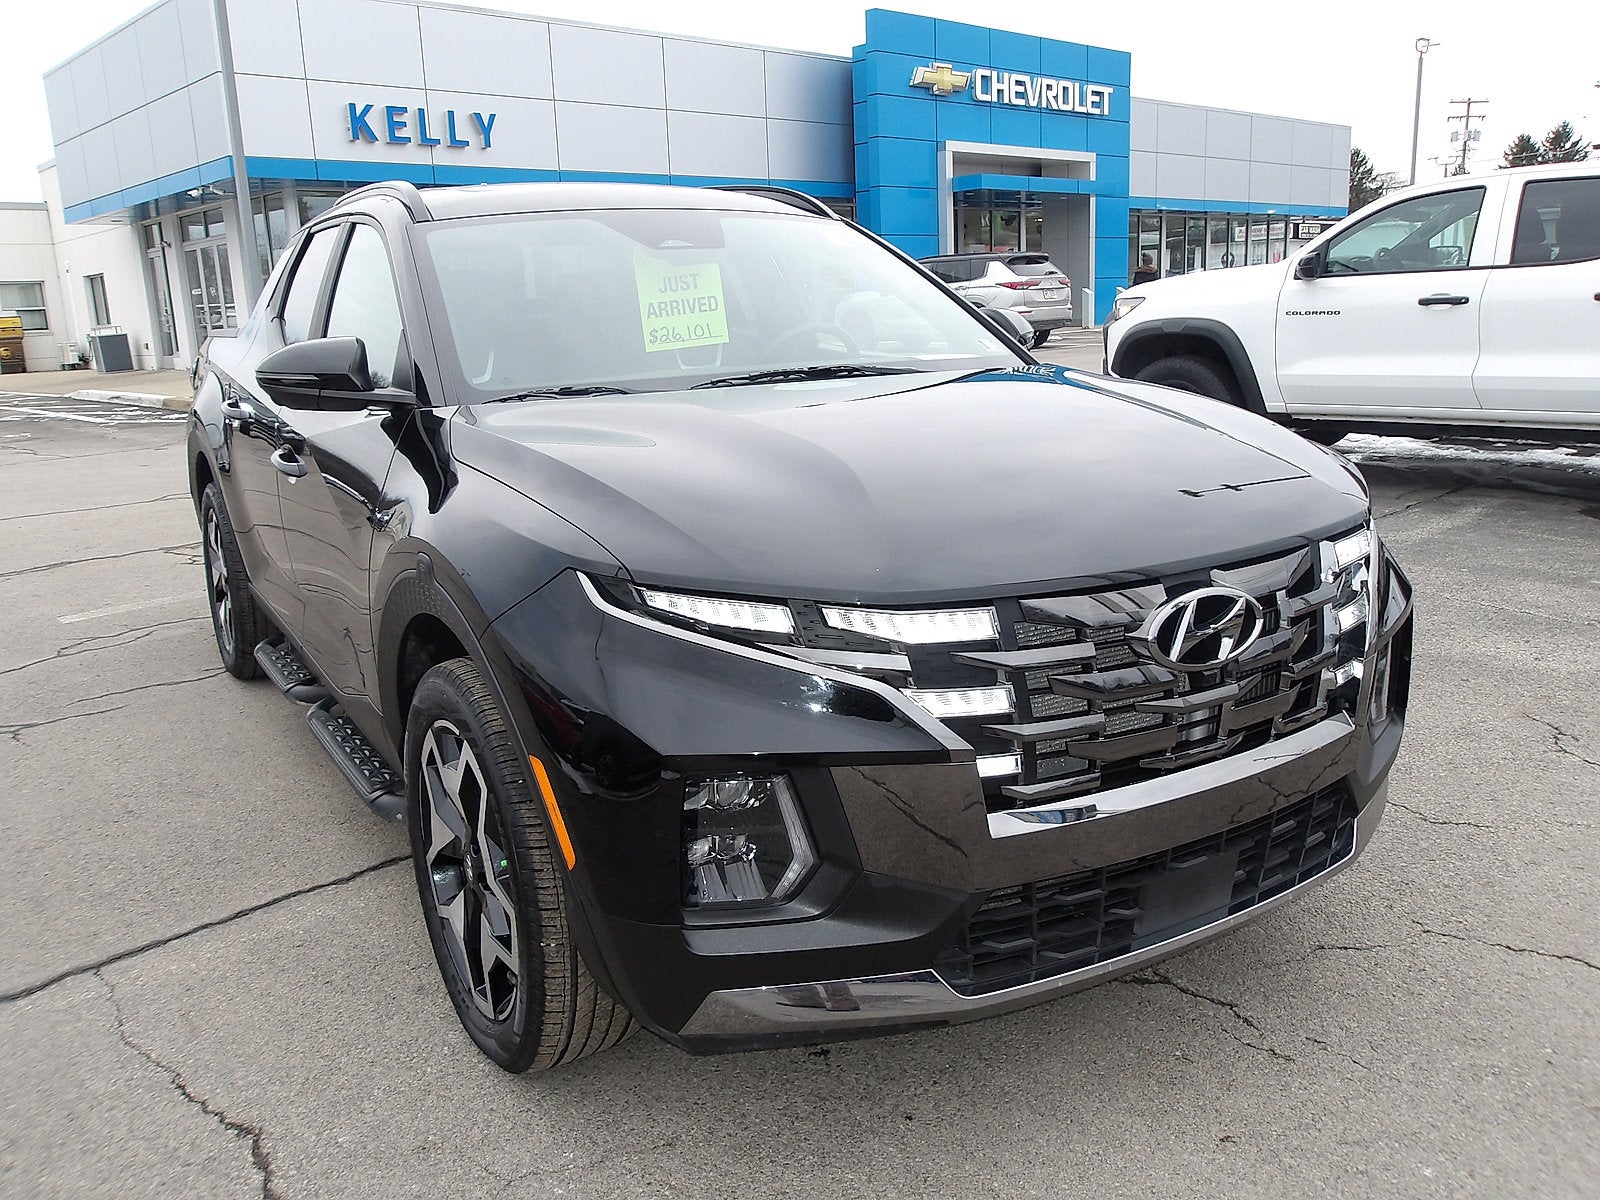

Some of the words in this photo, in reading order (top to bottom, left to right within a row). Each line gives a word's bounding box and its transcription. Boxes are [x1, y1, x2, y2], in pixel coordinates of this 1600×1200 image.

[972, 68, 1113, 116] CHEVROLET
[347, 102, 497, 150] KELLY
[658, 273, 700, 294] JUST
[646, 295, 719, 320] ARRIVED
[648, 322, 713, 346] $26,101
